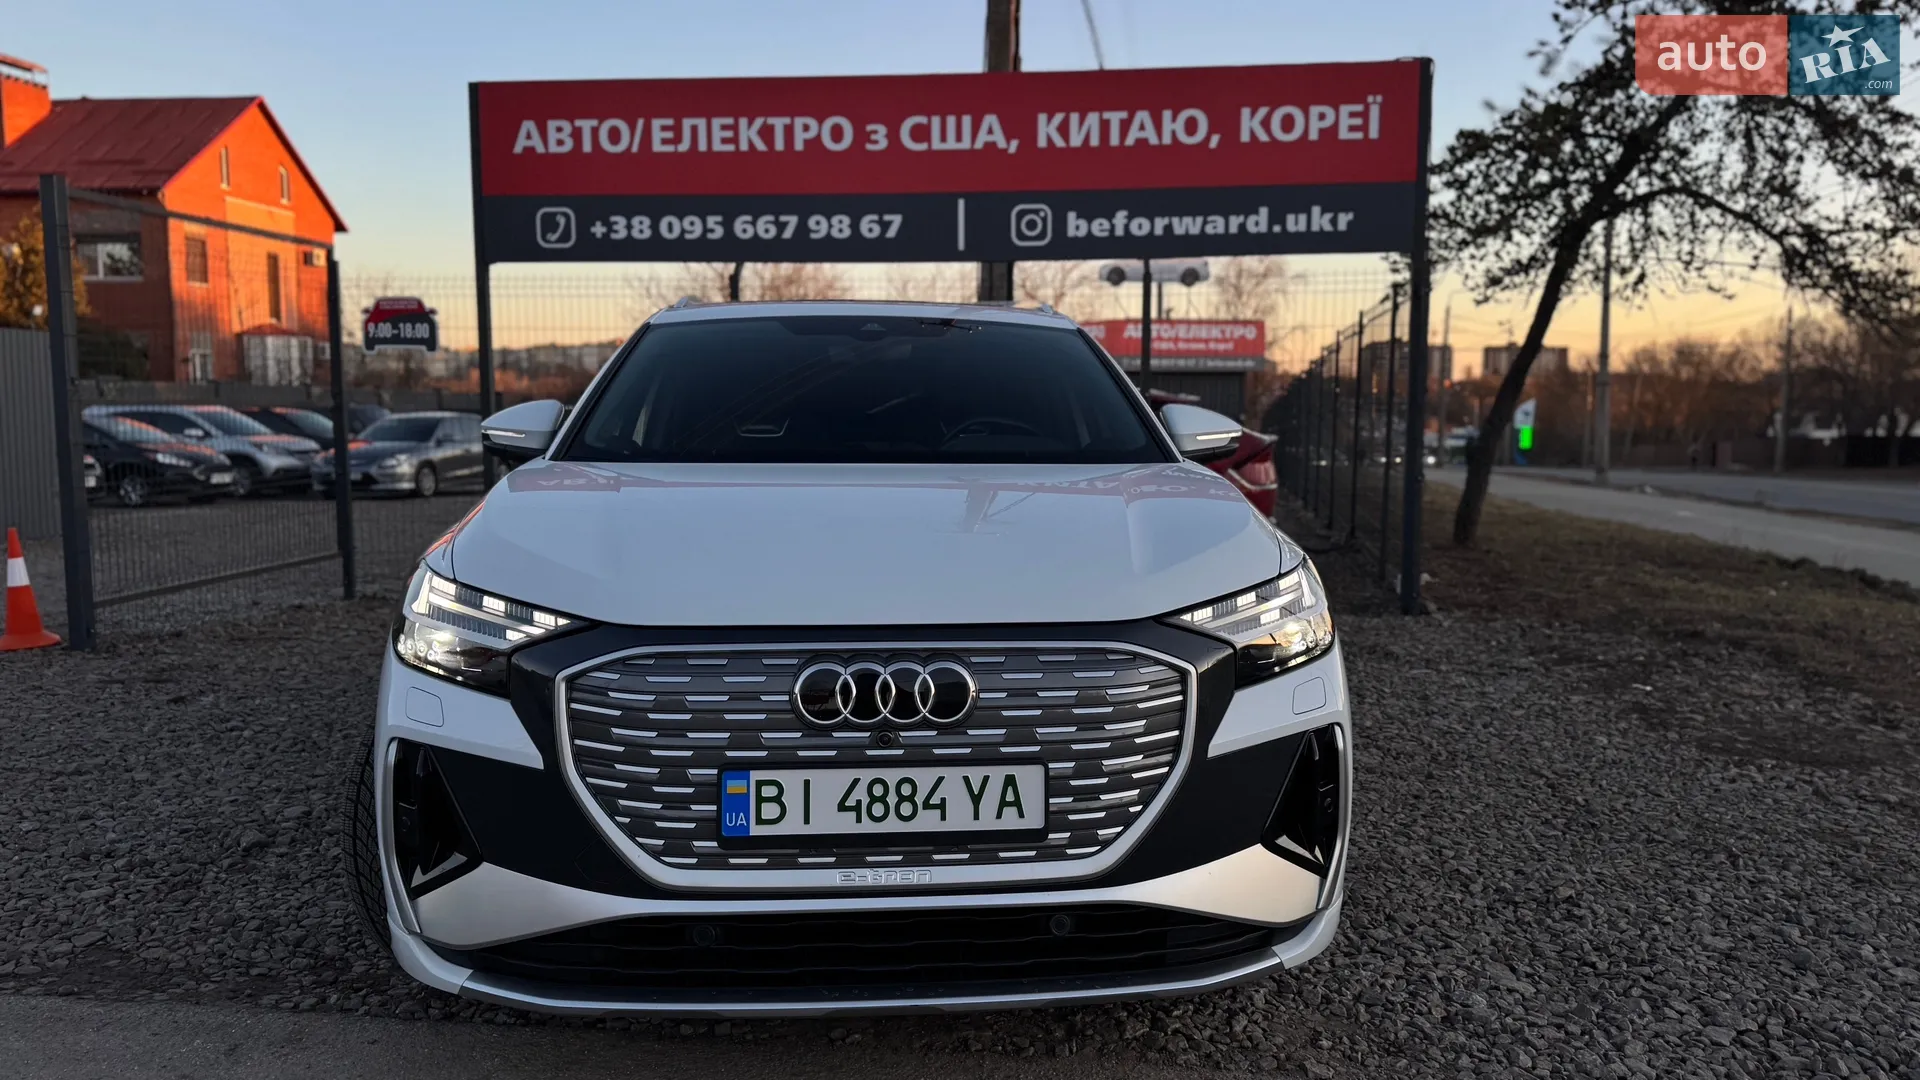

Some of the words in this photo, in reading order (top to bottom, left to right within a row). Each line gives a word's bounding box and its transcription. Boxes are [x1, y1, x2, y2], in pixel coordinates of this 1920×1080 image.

[513, 116, 853, 153] АВТО/ЕЛЕКТРО
[865, 123, 889, 151] з
[899, 115, 1019, 154] США,
[1037, 108, 1221, 149] КИТАЮ,
[1240, 95, 1382, 143] КОРЕЇ
[590, 215, 652, 240] +38
[659, 215, 724, 240] 095
[733, 214, 799, 240] 667
[807, 214, 852, 239] 98
[859, 214, 903, 239] 67
[1067, 205, 1354, 238] beforward.ukr
[755, 778, 811, 826] BI
[836, 775, 948, 824] 4884
[962, 773, 1026, 821] YA
[726, 812, 748, 827] UA
[836, 868, 933, 885] e-tron
